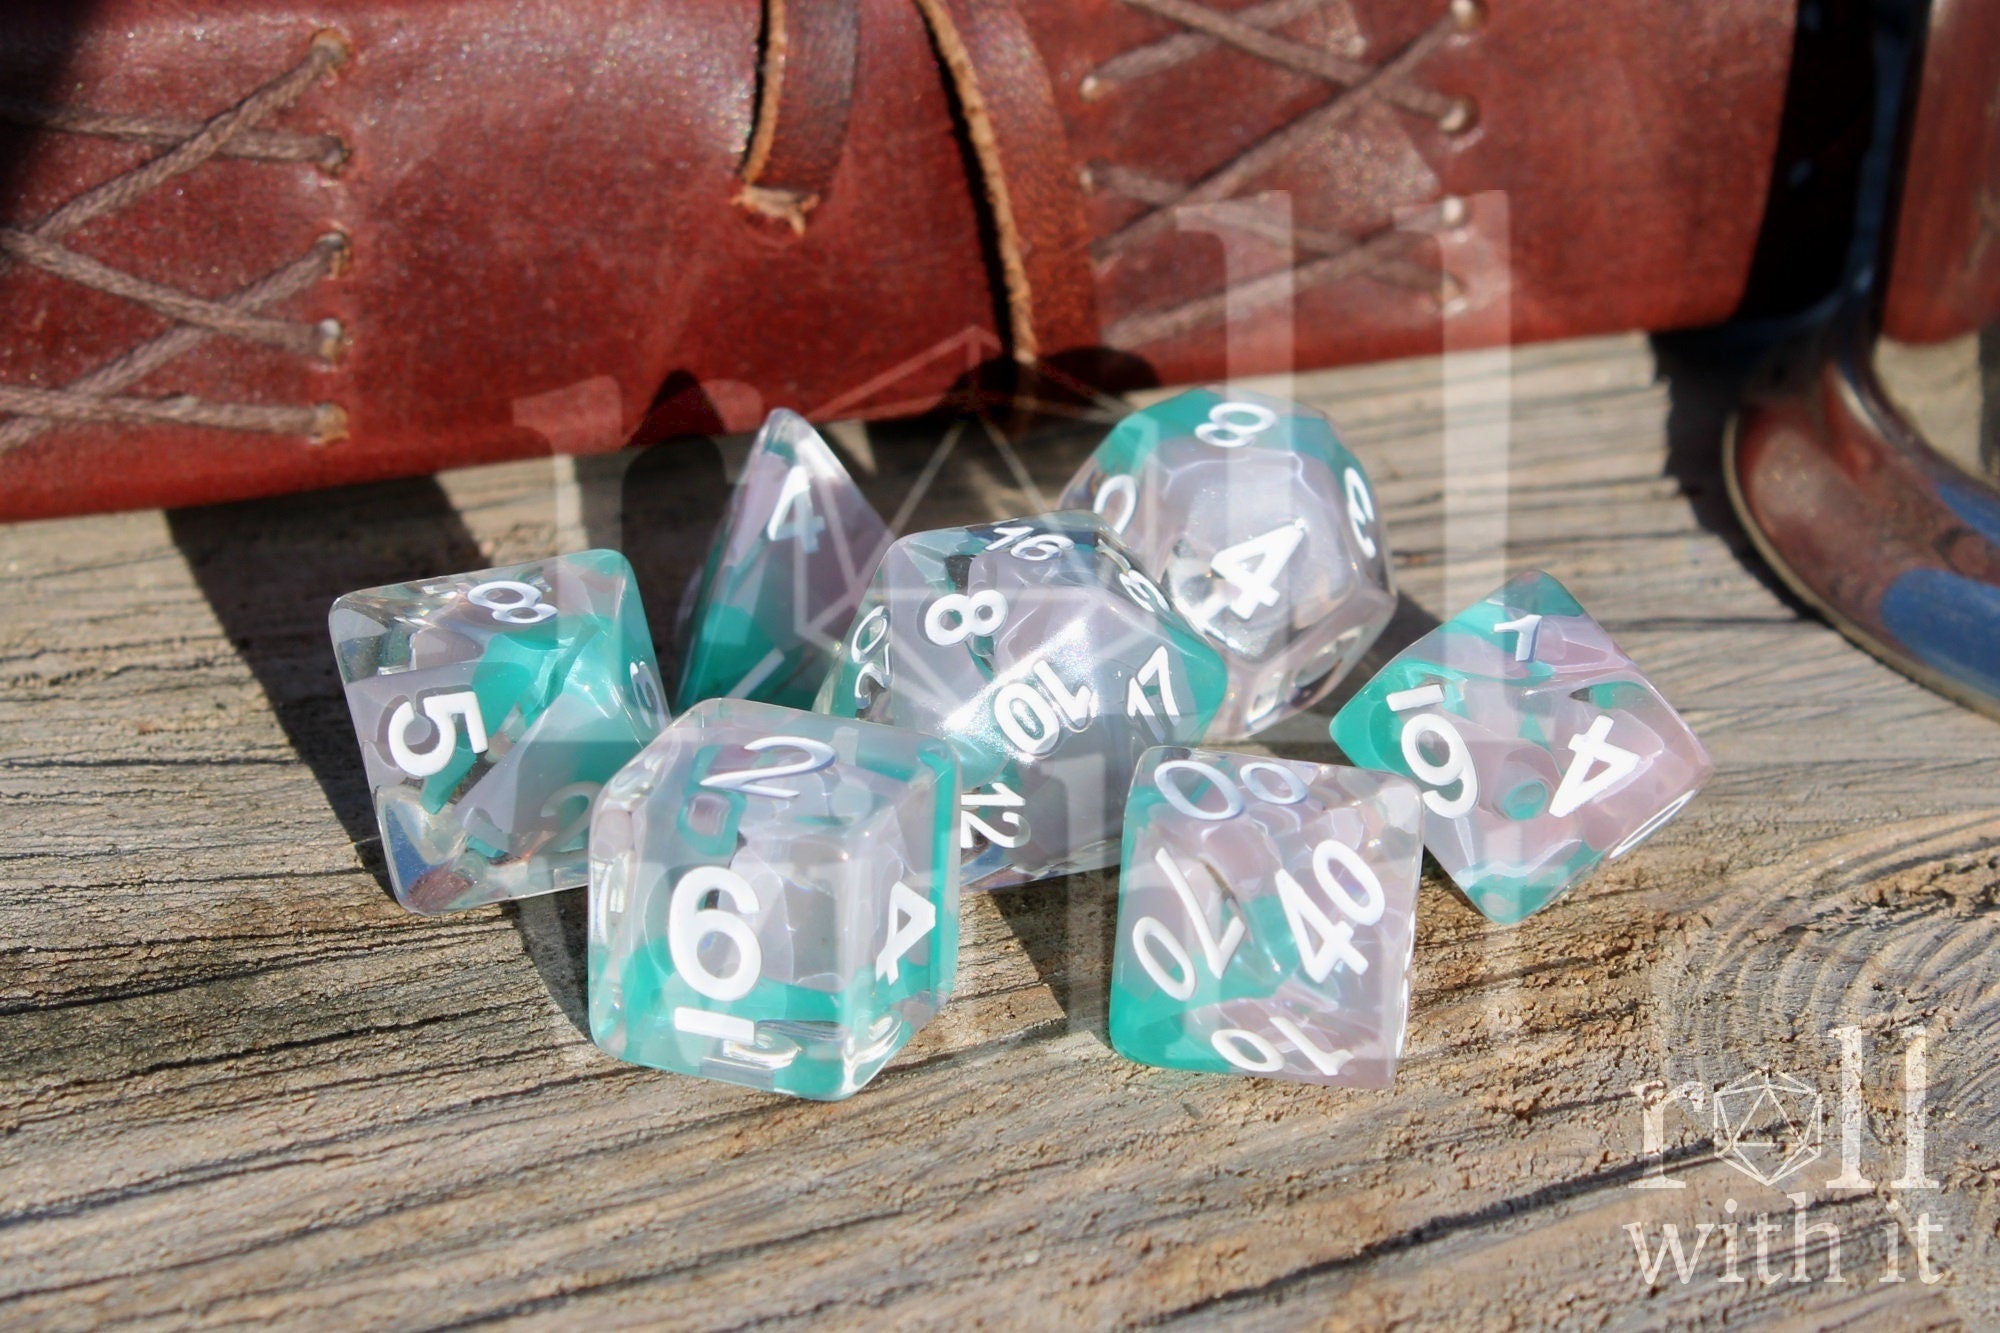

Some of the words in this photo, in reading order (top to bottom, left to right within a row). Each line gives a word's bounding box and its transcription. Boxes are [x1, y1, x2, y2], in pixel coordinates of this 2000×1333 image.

[1195, 402, 1277, 447] 8
[766, 465, 825, 554] 4
[1344, 467, 1377, 559] 3
[467, 580, 558, 624] 8
[1210, 519, 1303, 621] 4
[924, 589, 1006, 646] 8
[1493, 614, 1542, 662] 1
[388, 690, 489, 778] 5
[993, 660, 1098, 755] 10
[1127, 645, 1181, 743] 17
[699, 736, 837, 799] 2
[1154, 760, 1309, 820] 00
[1548, 715, 1641, 817] 4
[876, 881, 937, 986] 4
[1132, 847, 1247, 1001] 70
[1275, 840, 1386, 984] 40
